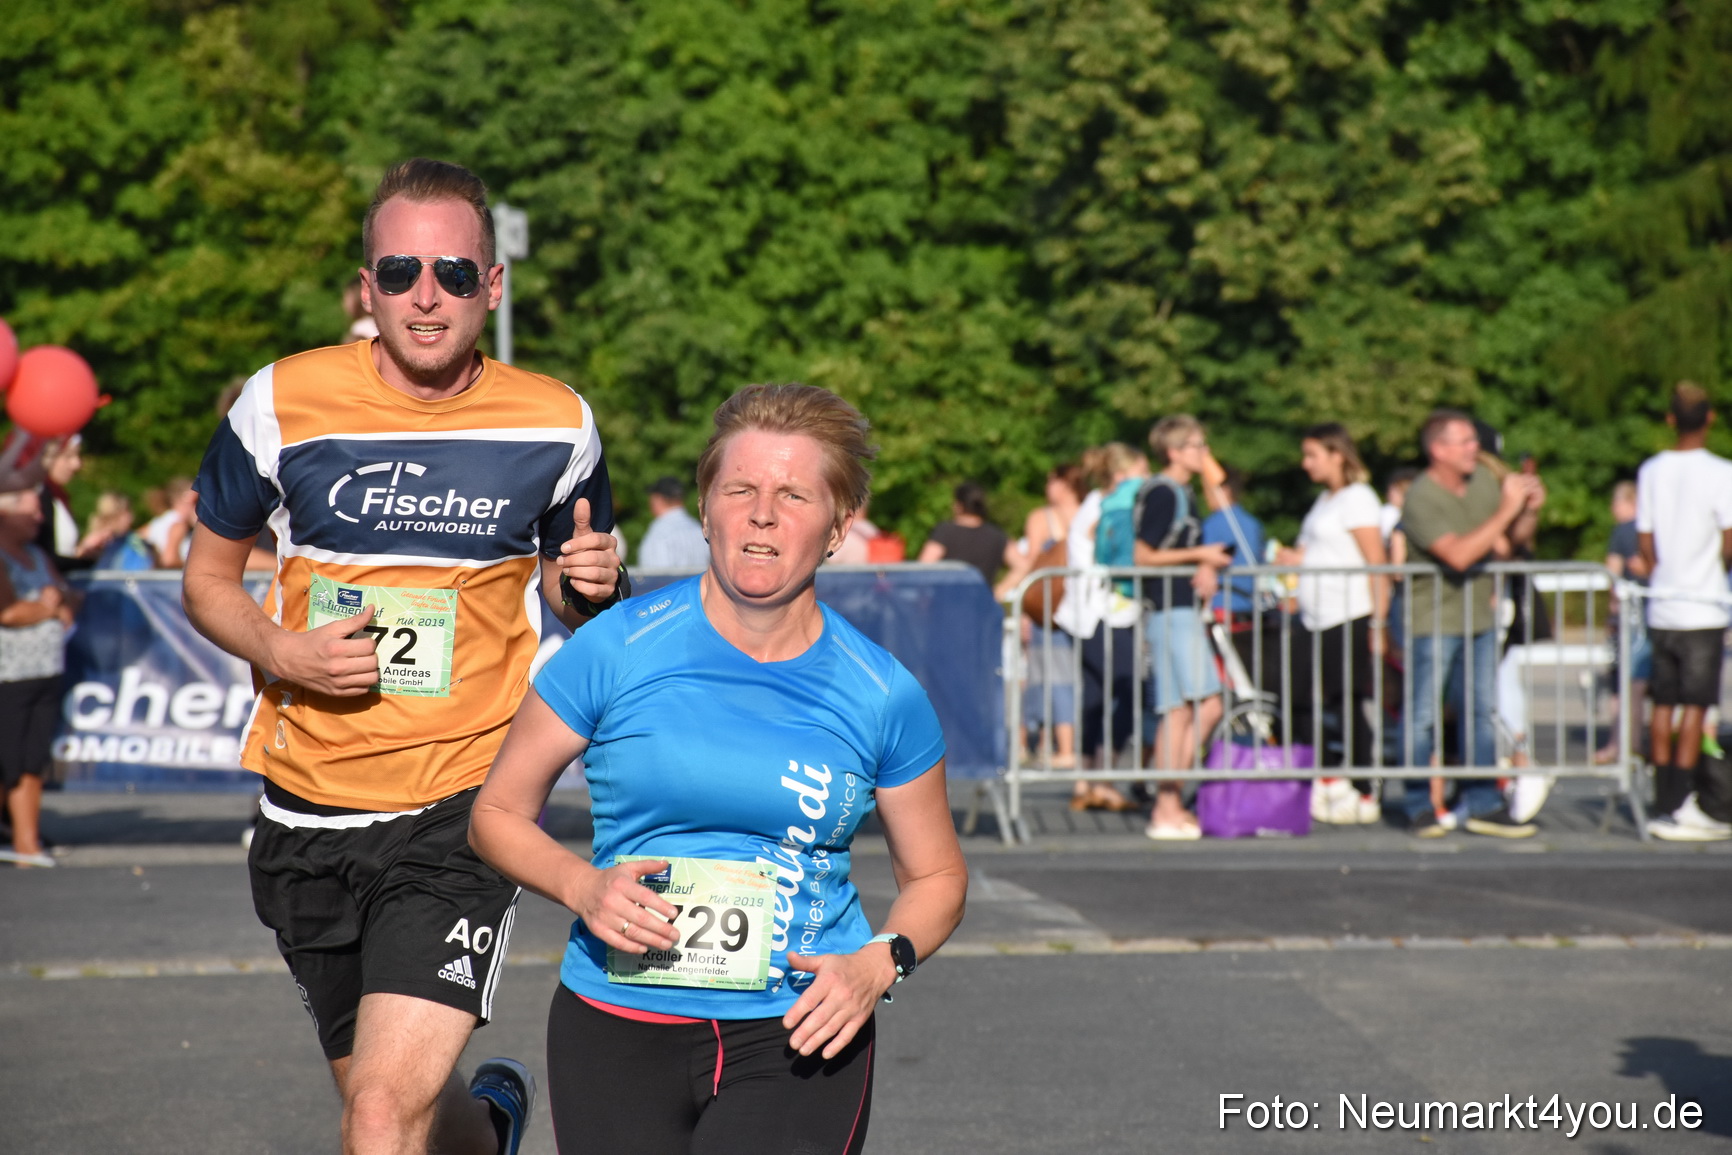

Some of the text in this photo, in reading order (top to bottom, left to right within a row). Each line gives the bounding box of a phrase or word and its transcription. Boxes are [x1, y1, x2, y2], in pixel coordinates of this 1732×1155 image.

[361, 488, 511, 520] Fischer
[373, 520, 498, 536] AUTOMOBILE
[649, 599, 672, 614] JAKO
[418, 618, 446, 627] 2019
[344, 625, 418, 666] 72
[383, 666, 431, 678] Andreas
[399, 678, 424, 686] GmbH
[781, 760, 832, 820] di
[733, 896, 764, 907] 2019
[642, 949, 727, 966] Kröller Moritz
[637, 962, 729, 977] Nathalie Lengenfelder
[438, 968, 476, 989] adidas
